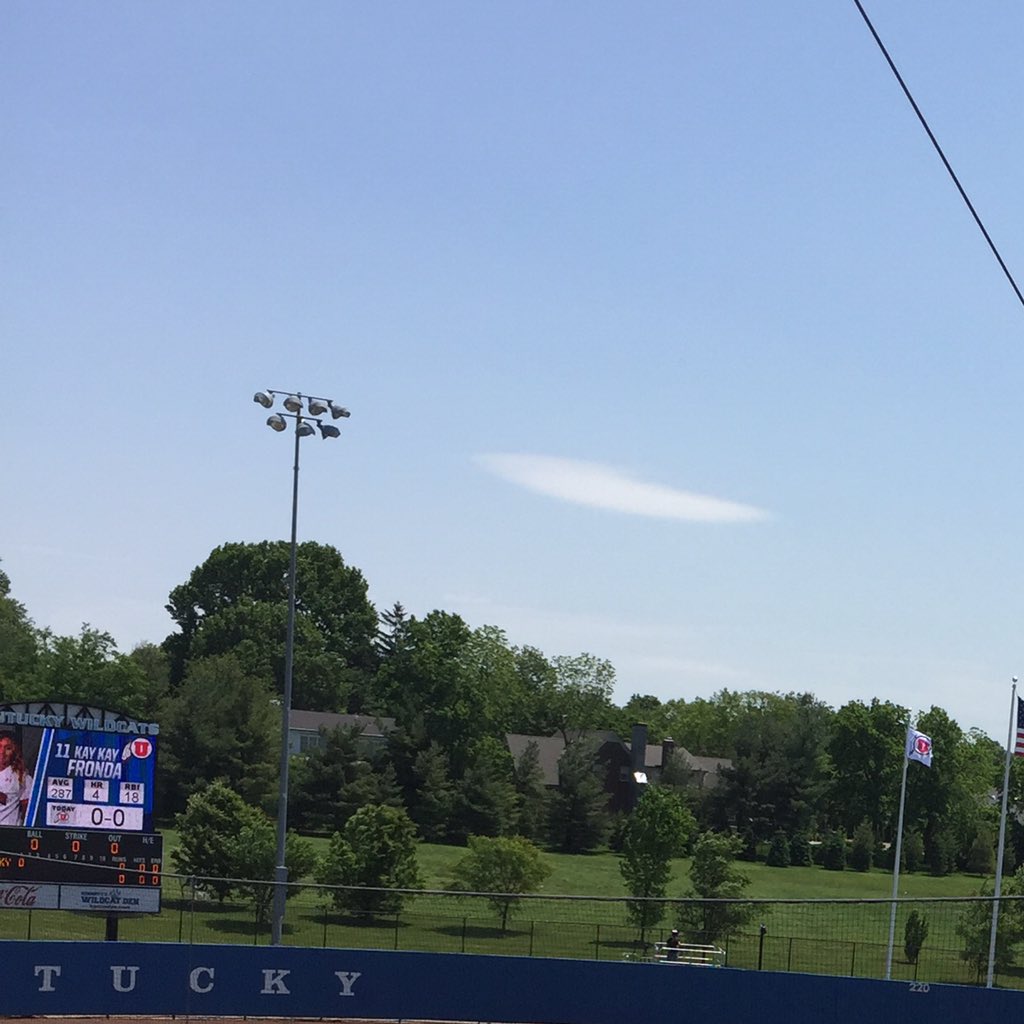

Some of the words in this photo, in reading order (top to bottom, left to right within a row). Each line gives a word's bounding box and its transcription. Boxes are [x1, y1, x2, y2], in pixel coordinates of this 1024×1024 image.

[71, 717, 160, 735] WILDCATS
[55, 743, 70, 758] 11
[74, 745, 96, 760] KAY
[97, 747, 119, 762] KAY
[67, 759, 122, 779] FRONDA
[90, 781, 103, 789] HR
[51, 788, 72, 798] 287
[92, 790, 100, 800] 4
[125, 792, 139, 803] 18
[91, 807, 125, 826] 0-0
[27, 830, 42, 838] BALL
[65, 832, 88, 840] STRIKE
[108, 834, 122, 842] OUT
[30, 838, 39, 850] 0
[72, 840, 80, 852] 0
[111, 842, 119, 854] 0
[18, 857, 25, 867] 0
[119, 874, 126, 884] 0
